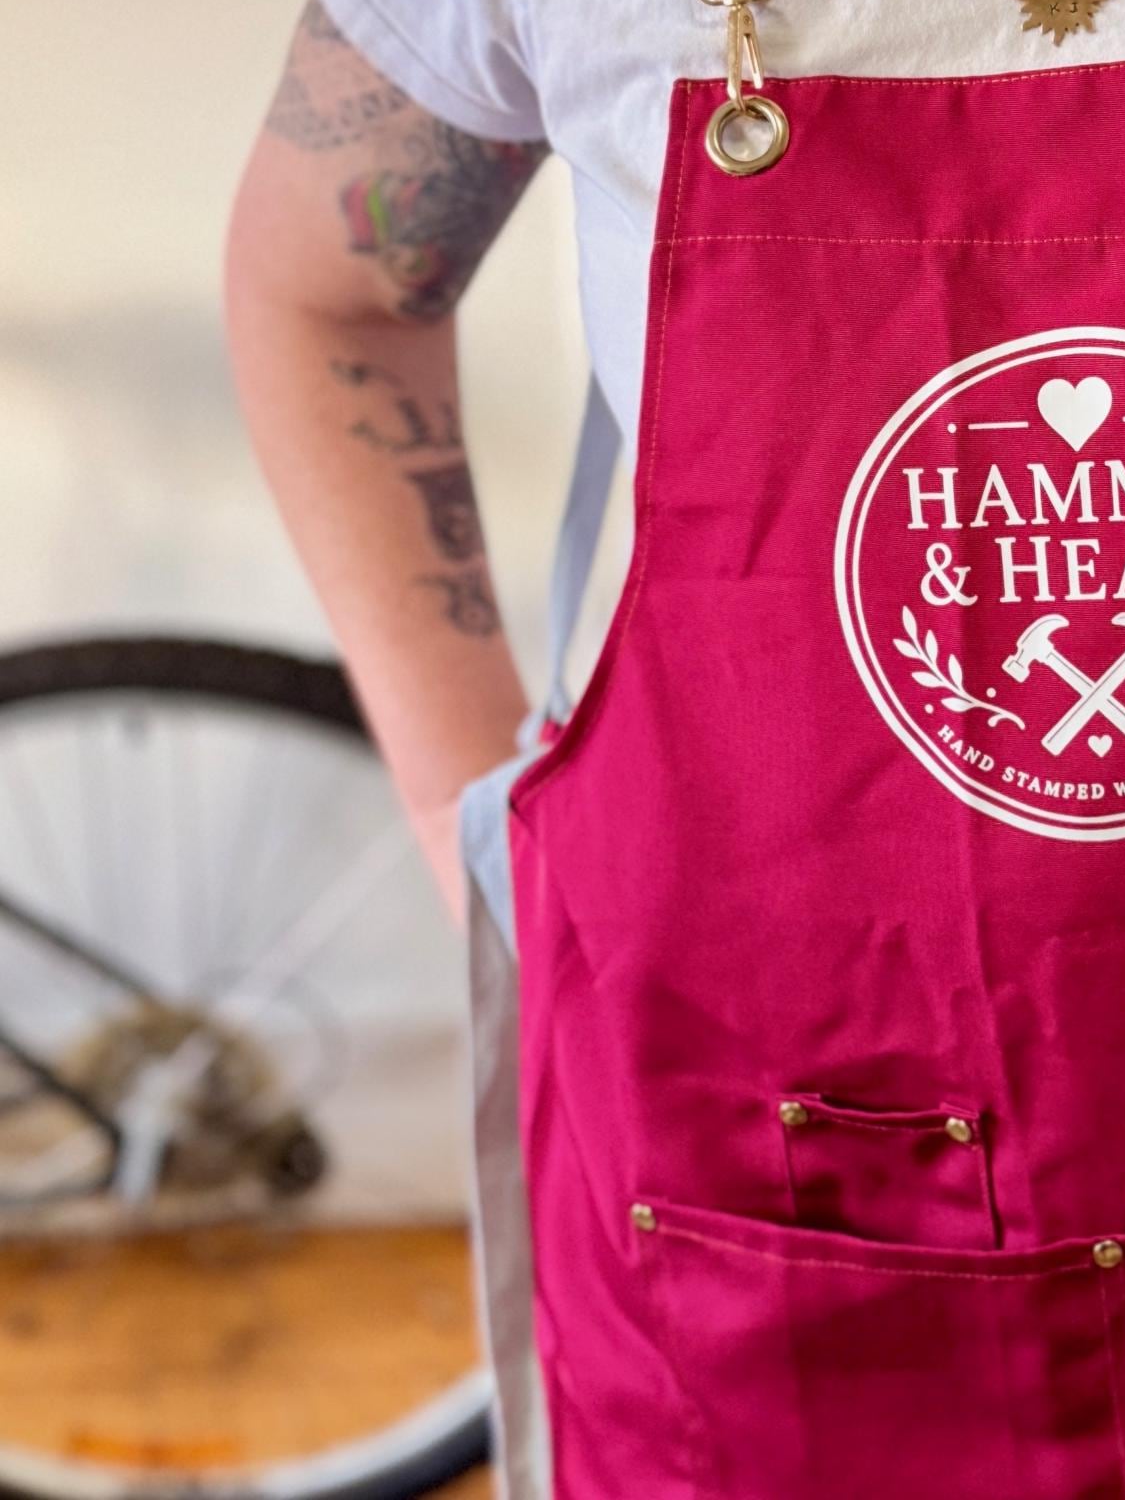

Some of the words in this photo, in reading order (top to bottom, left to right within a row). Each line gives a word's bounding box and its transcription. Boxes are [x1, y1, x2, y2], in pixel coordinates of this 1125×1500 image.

[920, 542, 978, 606] &
[937, 724, 995, 772] HAND
[1001, 766, 1105, 800] STAMPED
